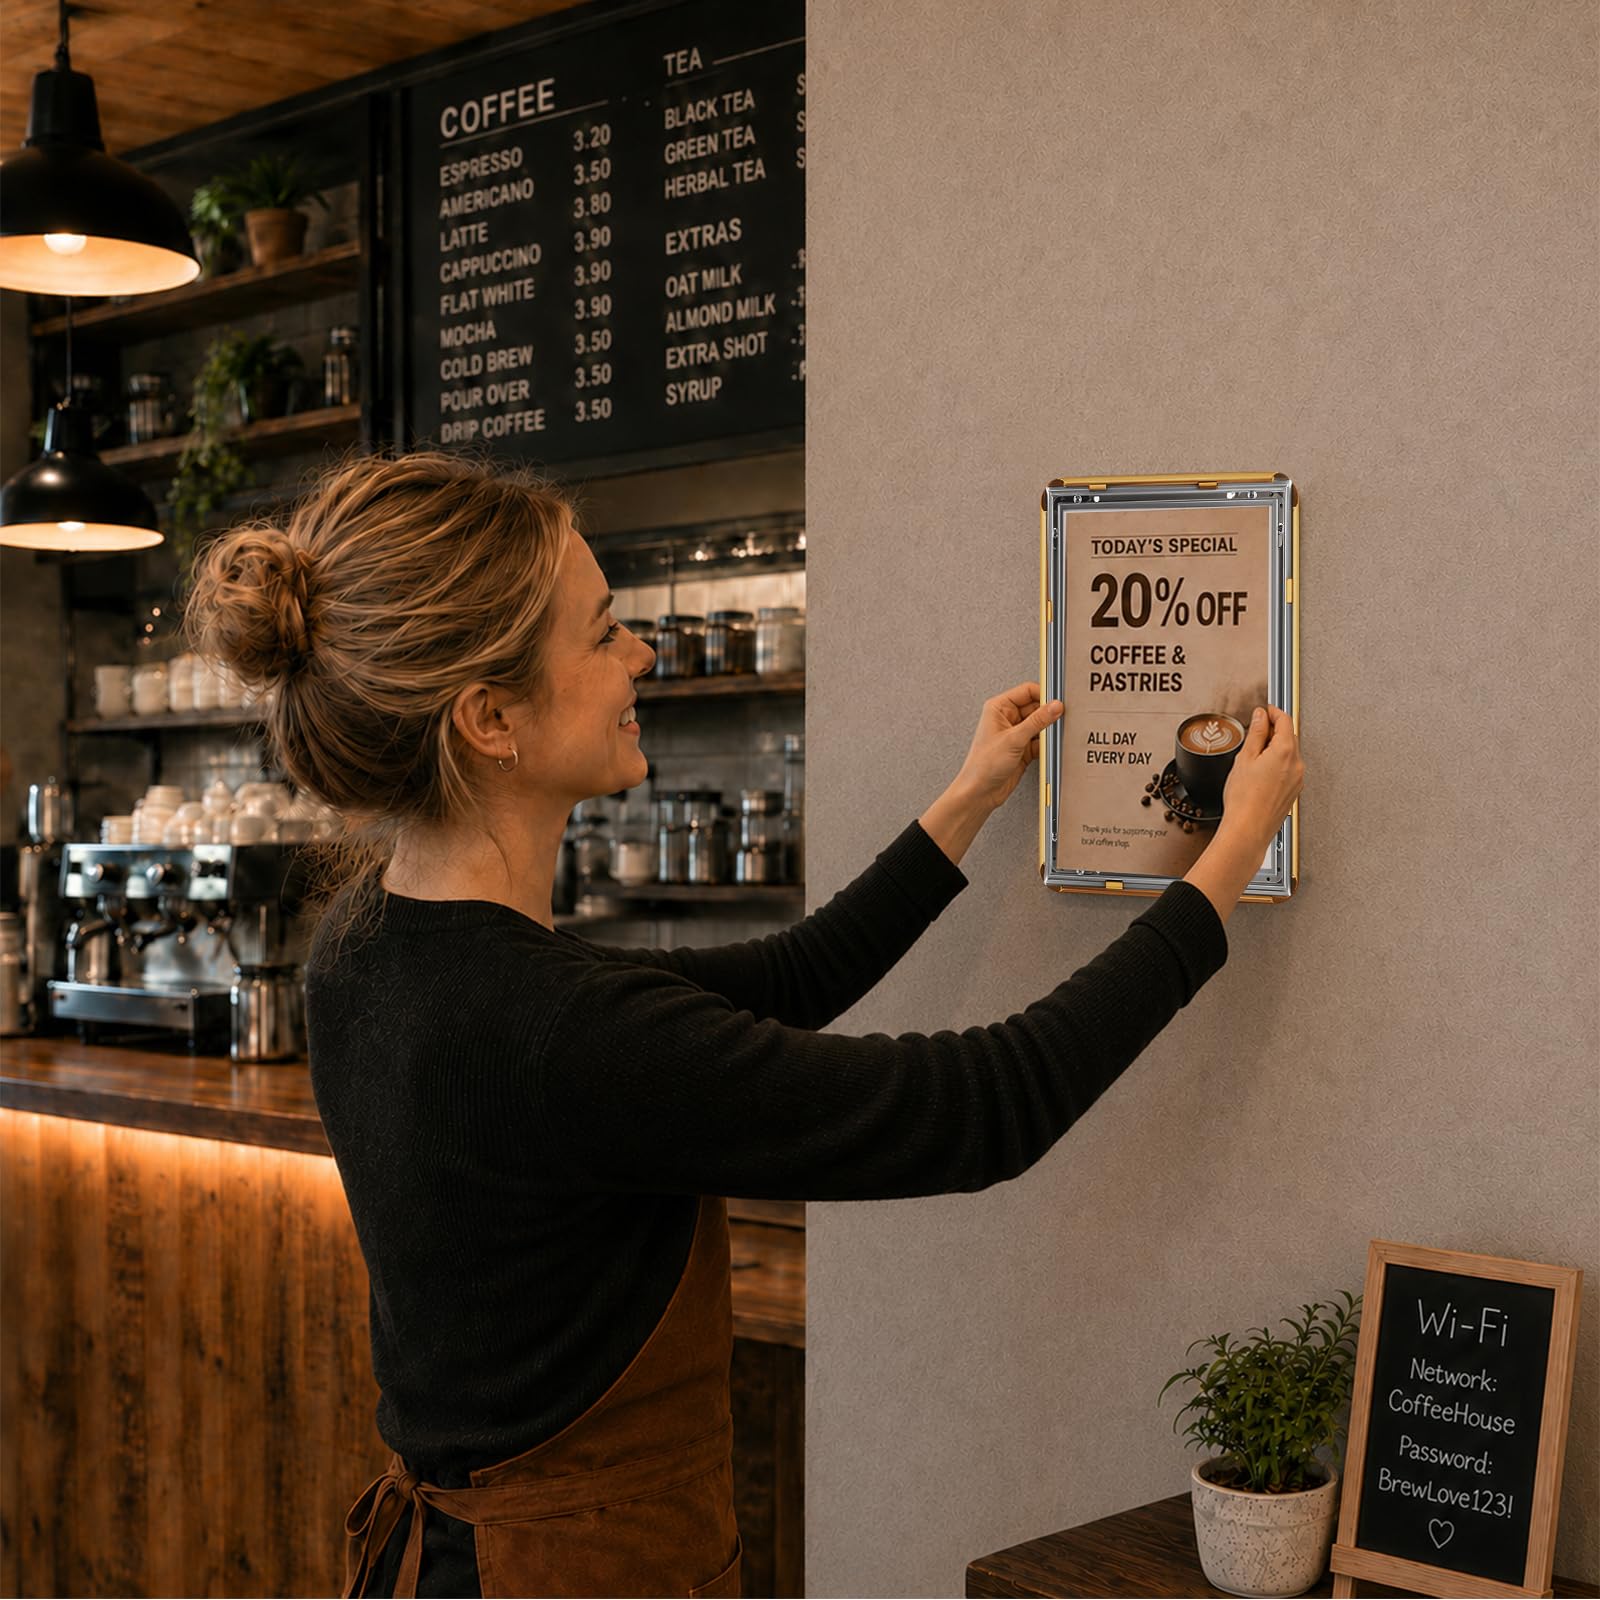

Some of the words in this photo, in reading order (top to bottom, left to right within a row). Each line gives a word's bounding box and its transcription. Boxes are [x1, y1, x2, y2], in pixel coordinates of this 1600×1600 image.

[663, 47, 703, 77] TEA
[440, 78, 555, 139] COFFEE
[664, 96, 718, 130] BLACK
[722, 88, 756, 115] TEA
[440, 147, 523, 187] ESPRESSO
[573, 123, 611, 151] 3.20
[664, 132, 718, 165] GREEN
[722, 124, 756, 150] TEA
[440, 178, 534, 219] AMERICANO
[573, 157, 611, 186] 3.50
[664, 167, 730, 199] HERBAL
[732, 158, 767, 185] TEA
[440, 222, 489, 252] LATTE
[573, 192, 611, 219] 3.80
[665, 217, 742, 256] EXTRAS
[440, 243, 542, 284] CAPPUCCINO
[573, 226, 611, 253] 3.90
[440, 289, 480, 317] FLAT
[482, 278, 536, 307] WHITE
[574, 260, 611, 287] 3.90
[665, 271, 699, 299] OAT
[702, 263, 743, 292] MILK
[440, 319, 497, 348] MOCHA
[574, 294, 612, 321] 3.90
[665, 301, 733, 334] ALMOND
[736, 292, 776, 321] MILK
[440, 354, 483, 381] COLD
[486, 344, 534, 373] BREW
[574, 329, 612, 355] 3.50
[665, 341, 720, 370] EXTRA
[723, 331, 769, 360] SHOT
[440, 386, 484, 414] POUR
[486, 379, 530, 405] OVER
[575, 363, 612, 389] 3.50
[665, 376, 723, 406] SYRUP
[440, 418, 480, 444] DRIP
[481, 408, 546, 439] COFFEE
[574, 397, 612, 423] 3.50
[1168, 536, 1238, 553] SPECIAL
[1090, 572, 1190, 629] 20%
[1196, 591, 1248, 626] OFF
[1090, 645, 1167, 666] COFFEE
[1172, 645, 1187, 666] &
[1089, 672, 1183, 693] PASTRIES
[1086, 751, 1125, 764] EVERY
[1128, 753, 1152, 765] DAY
[1087, 732, 1110, 745] ALL
[1112, 732, 1137, 746] DAY
[1418, 1299, 1509, 1347] Wi-Fi
[1409, 1357, 1498, 1392] Network:
[1388, 1389, 1516, 1435] CoffeeHouse
[1399, 1435, 1493, 1475] Password:
[1378, 1468, 1514, 1518] BrewLove123!
